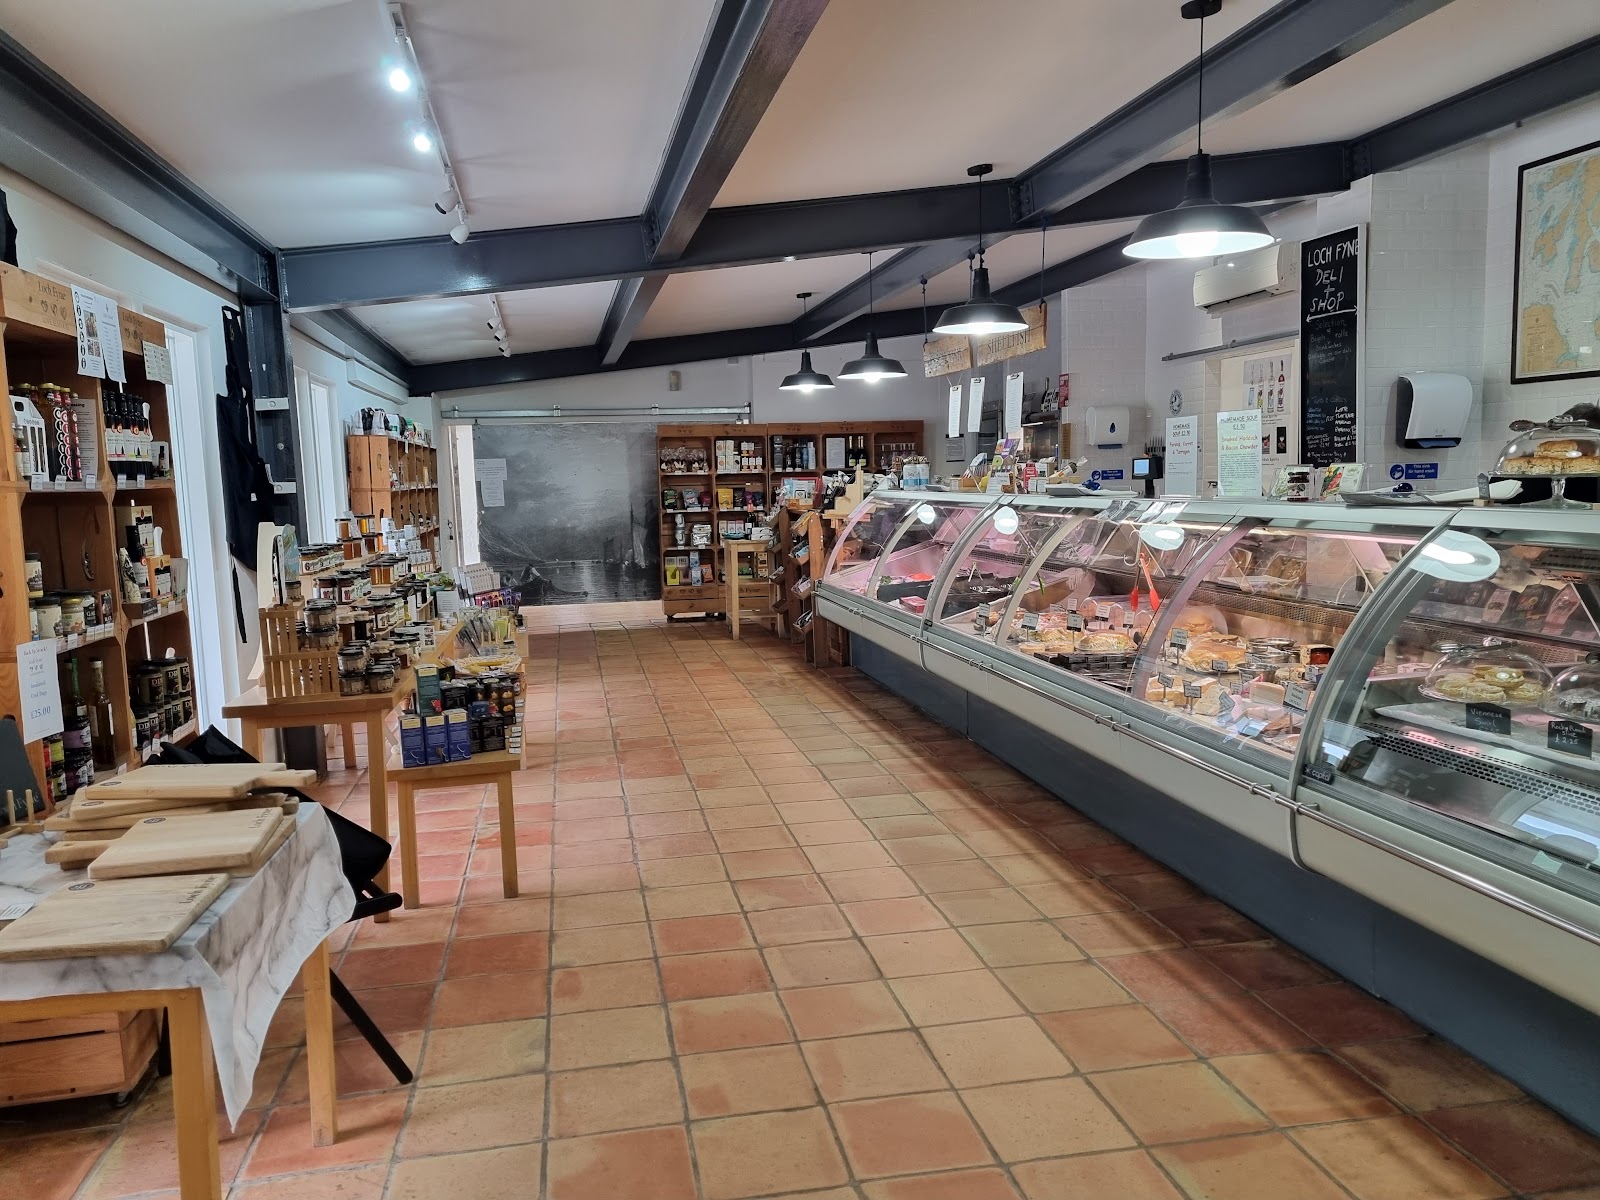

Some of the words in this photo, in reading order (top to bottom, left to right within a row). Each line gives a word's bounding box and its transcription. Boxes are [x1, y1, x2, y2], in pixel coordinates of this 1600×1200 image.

[1307, 246, 1332, 268] LOCH
[1315, 266, 1344, 286] DELI
[38, 281, 52, 296] Loch
[52, 286, 67, 302] Fyne
[1309, 291, 1345, 312] SHOP
[987, 326, 1032, 355] SHELLFISH
[1239, 434, 1258, 442] Haddock
[30, 705, 51, 720] £25.00
[1470, 708, 1503, 719] Viennese
[1474, 717, 1497, 727] Swirl
[1550, 721, 1569, 733] Rocky
